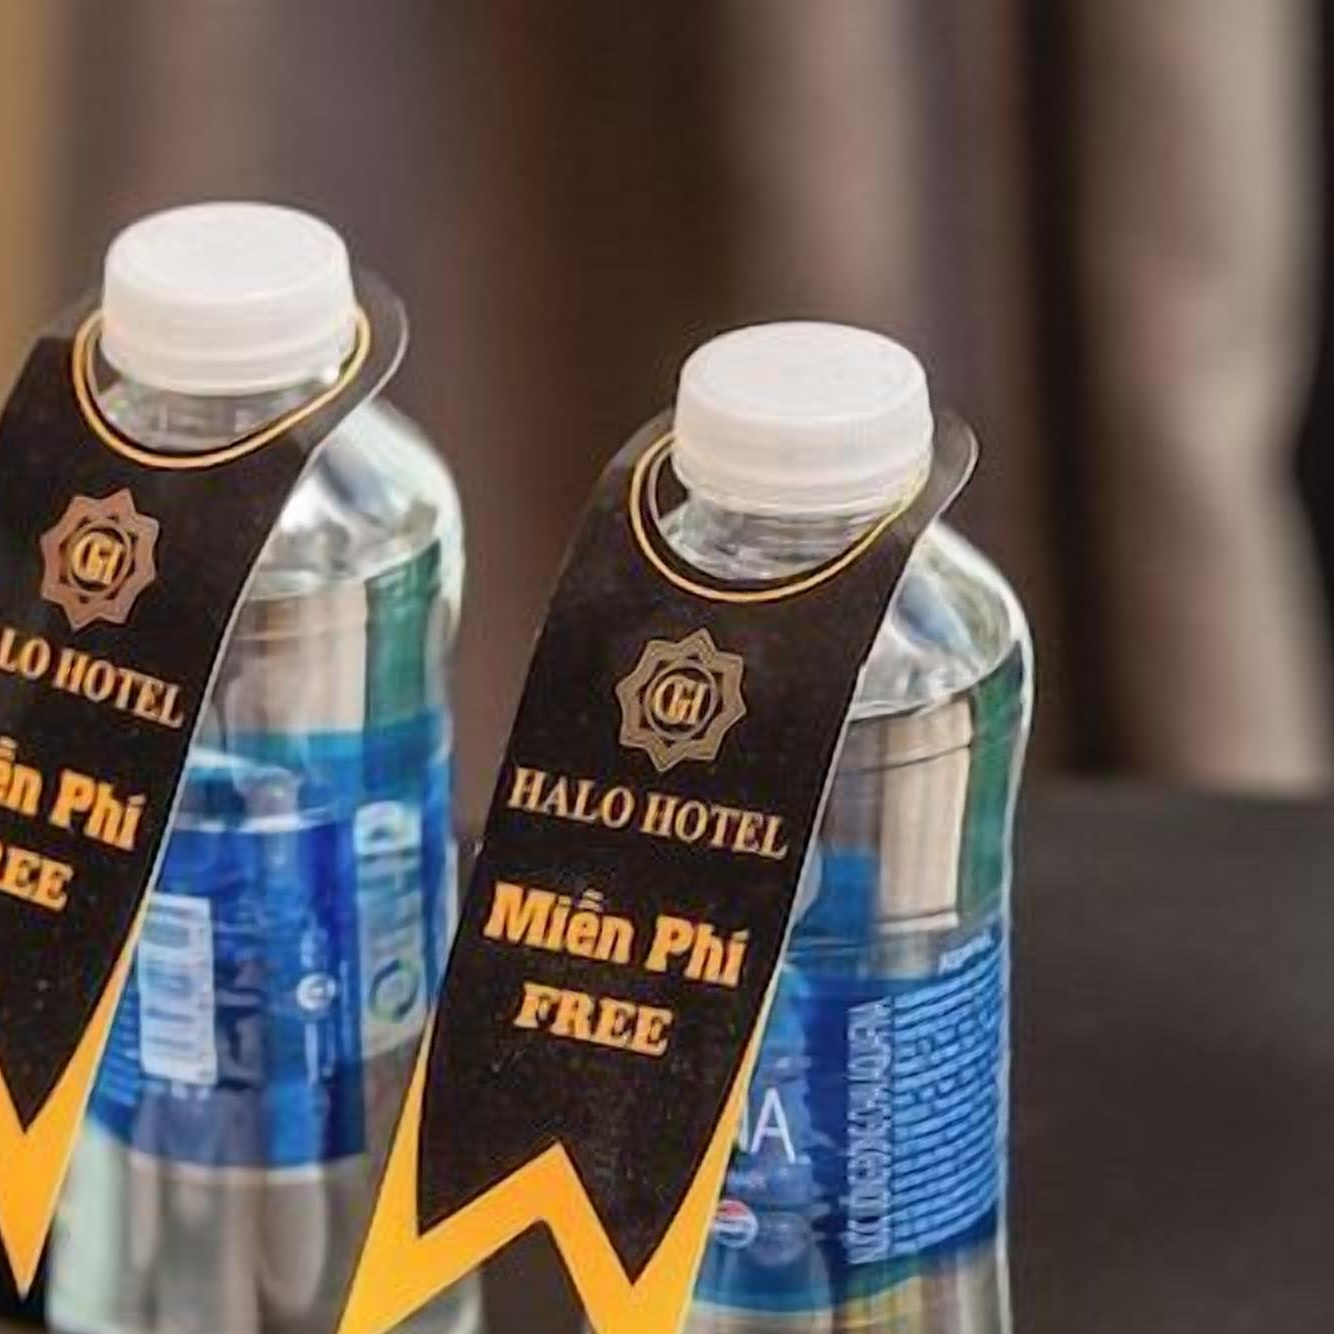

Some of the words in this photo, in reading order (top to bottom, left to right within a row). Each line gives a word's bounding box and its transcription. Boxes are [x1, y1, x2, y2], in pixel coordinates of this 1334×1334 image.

[53, 648, 184, 728] HOTEL
[49, 768, 146, 851] Phí
[507, 767, 635, 829] HALO
[640, 792, 788, 860] HOTEL
[645, 914, 749, 988] Phí
[513, 982, 673, 1057] FREE
